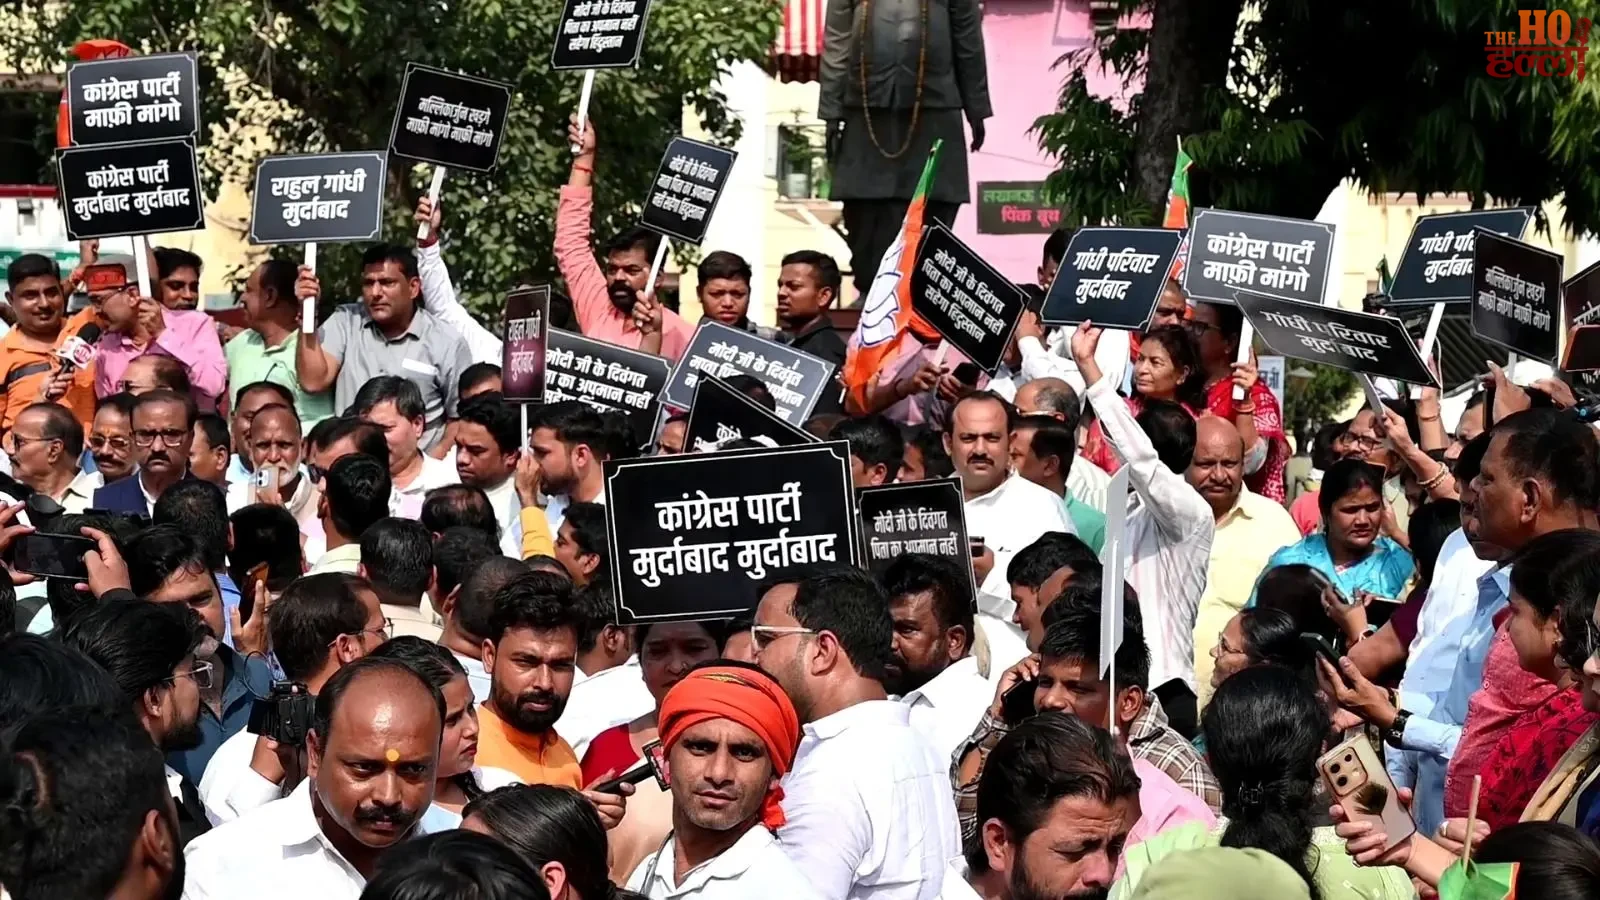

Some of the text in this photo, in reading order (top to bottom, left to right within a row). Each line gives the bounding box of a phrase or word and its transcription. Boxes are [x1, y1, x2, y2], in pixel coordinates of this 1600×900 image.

[82, 71, 181, 102] कांग्रेस पार्टी
[83, 97, 182, 128] माफ़ी मांगो
[429, 120, 451, 139] मांगो
[473, 128, 494, 147] मांगो
[86, 159, 170, 189] कांग्रेस पार्टी
[270, 168, 367, 200] राहुल गांधी
[72, 185, 190, 221] मुर्दाबाद मुर्दाबाद
[282, 195, 351, 227] मुर्दाबाद
[1208, 233, 1316, 265] कांग्रेस पार्टी
[1418, 230, 1456, 255] गांधी
[1072, 246, 1160, 275] गांधी परिवार
[1203, 259, 1311, 292] माफ़ी मांगो
[921, 257, 1007, 336] पिता का अपमान नहीं
[934, 248, 1006, 315] मोदी जी के दिवंगत
[1075, 274, 1132, 304] मुर्दाबाद
[508, 309, 541, 347] राहुल गांधी
[924, 284, 987, 344] सहेगा हिंदुस्तान
[1260, 310, 1392, 349] गांधी परिवार
[1496, 297, 1514, 319] मांगो
[1532, 309, 1552, 333] मांगो
[510, 344, 536, 383] मुर्दाबाद
[574, 355, 593, 377] जी
[592, 359, 607, 377] के
[606, 363, 648, 389] दिवंगत
[708, 341, 739, 361] मोदी
[737, 351, 755, 369] जी
[752, 355, 769, 373] के
[557, 373, 575, 390] का
[575, 377, 625, 403] अपमान
[624, 392, 654, 409] नहीं
[655, 482, 802, 531] कांग्रेस पार्टी
[872, 507, 948, 533] मोदी जी के दिवंगत
[629, 528, 838, 587] मुर्दाबाद मुर्दाबाद
[870, 536, 890, 560] पिता
[889, 541, 903, 557] का
[938, 531, 959, 556] नहीं
